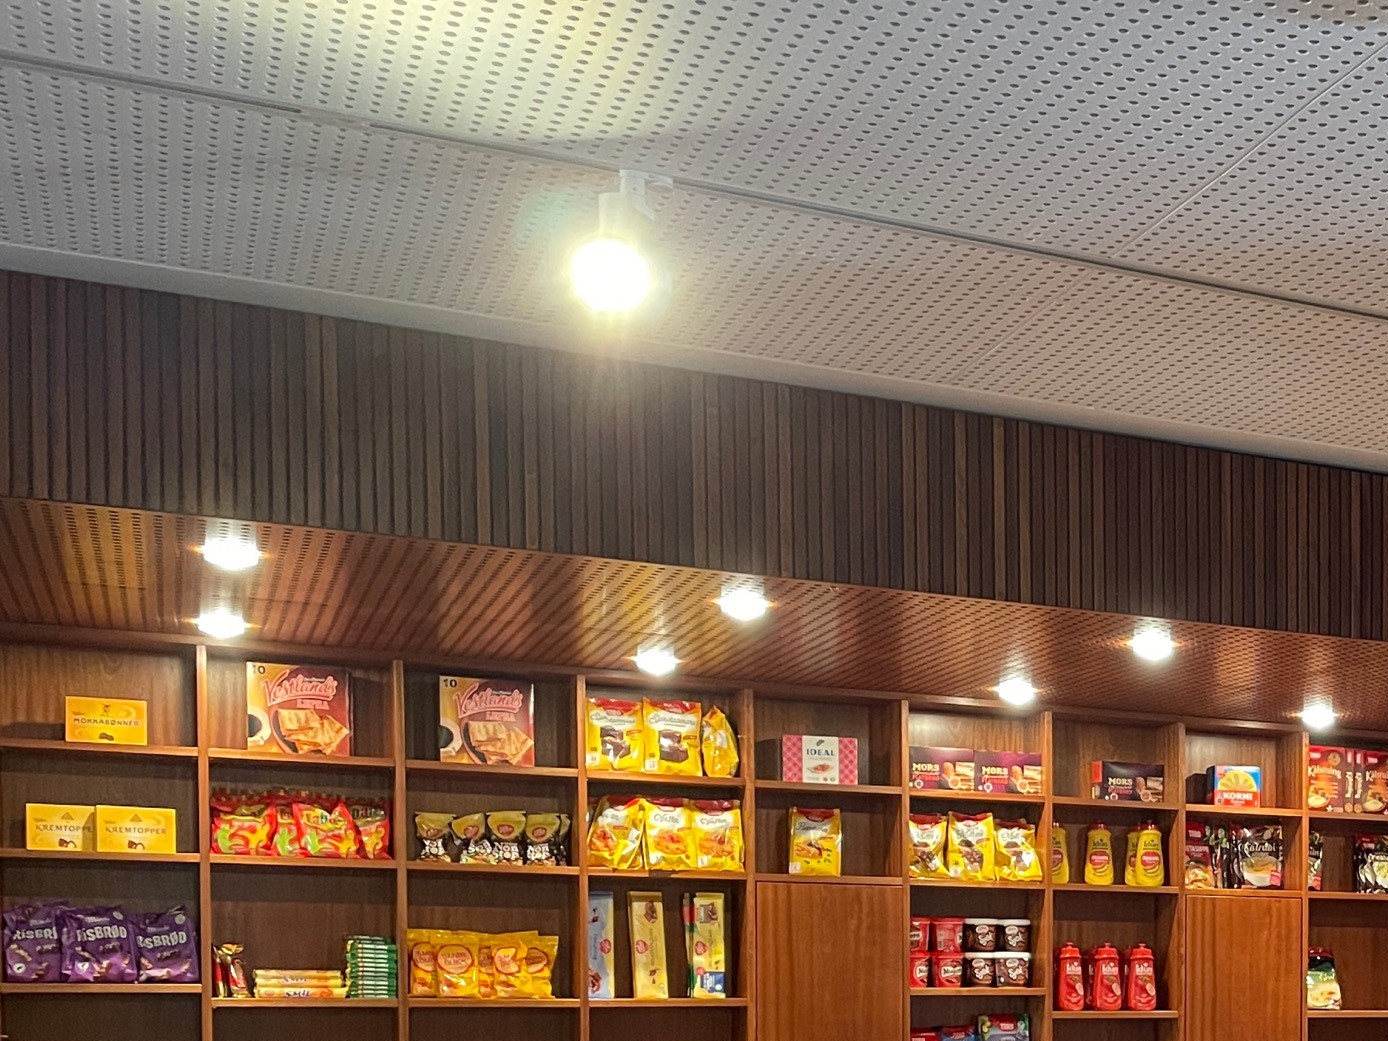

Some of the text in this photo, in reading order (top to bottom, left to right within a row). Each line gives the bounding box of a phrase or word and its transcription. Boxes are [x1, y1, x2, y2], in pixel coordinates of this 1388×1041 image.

[806, 748, 835, 757] IDEAL
[912, 762, 940, 772] MORS
[1108, 776, 1134, 787] MORS
[1222, 791, 1254, 801] KORNI
[35, 823, 95, 834] KREMTOPPE
[105, 825, 168, 836] KREMTOPPER
